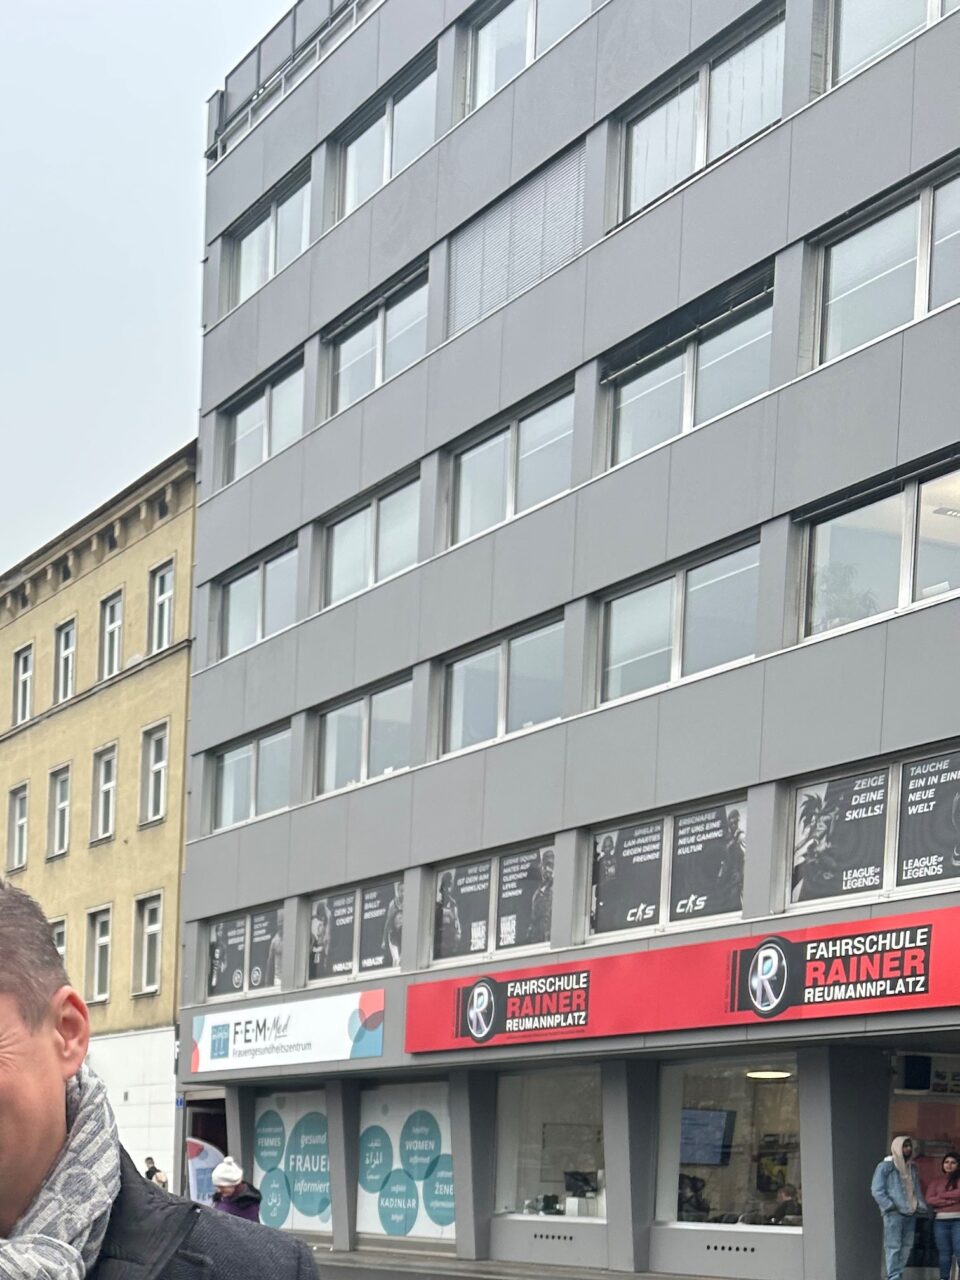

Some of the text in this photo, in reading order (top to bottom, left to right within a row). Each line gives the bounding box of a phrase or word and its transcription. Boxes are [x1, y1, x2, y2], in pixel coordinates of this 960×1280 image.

[910, 759, 950, 776] TAUCHE
[853, 774, 885, 791] ZEIGE
[909, 777, 926, 790] EIN
[927, 775, 939, 786] IN
[851, 789, 885, 806] DEINE
[908, 788, 936, 802] NEUE
[845, 804, 884, 821] SKILLS!
[908, 801, 936, 815] WELT
[678, 820, 721, 836] MIT UNS EINE
[696, 829, 723, 842] GAMING
[677, 843, 703, 856] KULTUR
[903, 855, 938, 870] LEAGUE
[843, 867, 875, 881] LEAGUE
[902, 865, 944, 880] LEGENDS
[842, 876, 881, 890] LEGENDS
[806, 928, 928, 961] FAHRSCHULE
[805, 948, 926, 987] RAINER
[507, 973, 588, 997] FAHRSCHULE
[804, 976, 925, 1003] REUMANNPLATZ
[506, 989, 586, 1019] RAINER
[506, 1011, 586, 1032] REUMANNPLATZ
[300, 1132, 327, 1148] gesund
[405, 1140, 435, 1151] WOMEN
[289, 1154, 330, 1172] FRAUE
[294, 1178, 330, 1195] informiert
